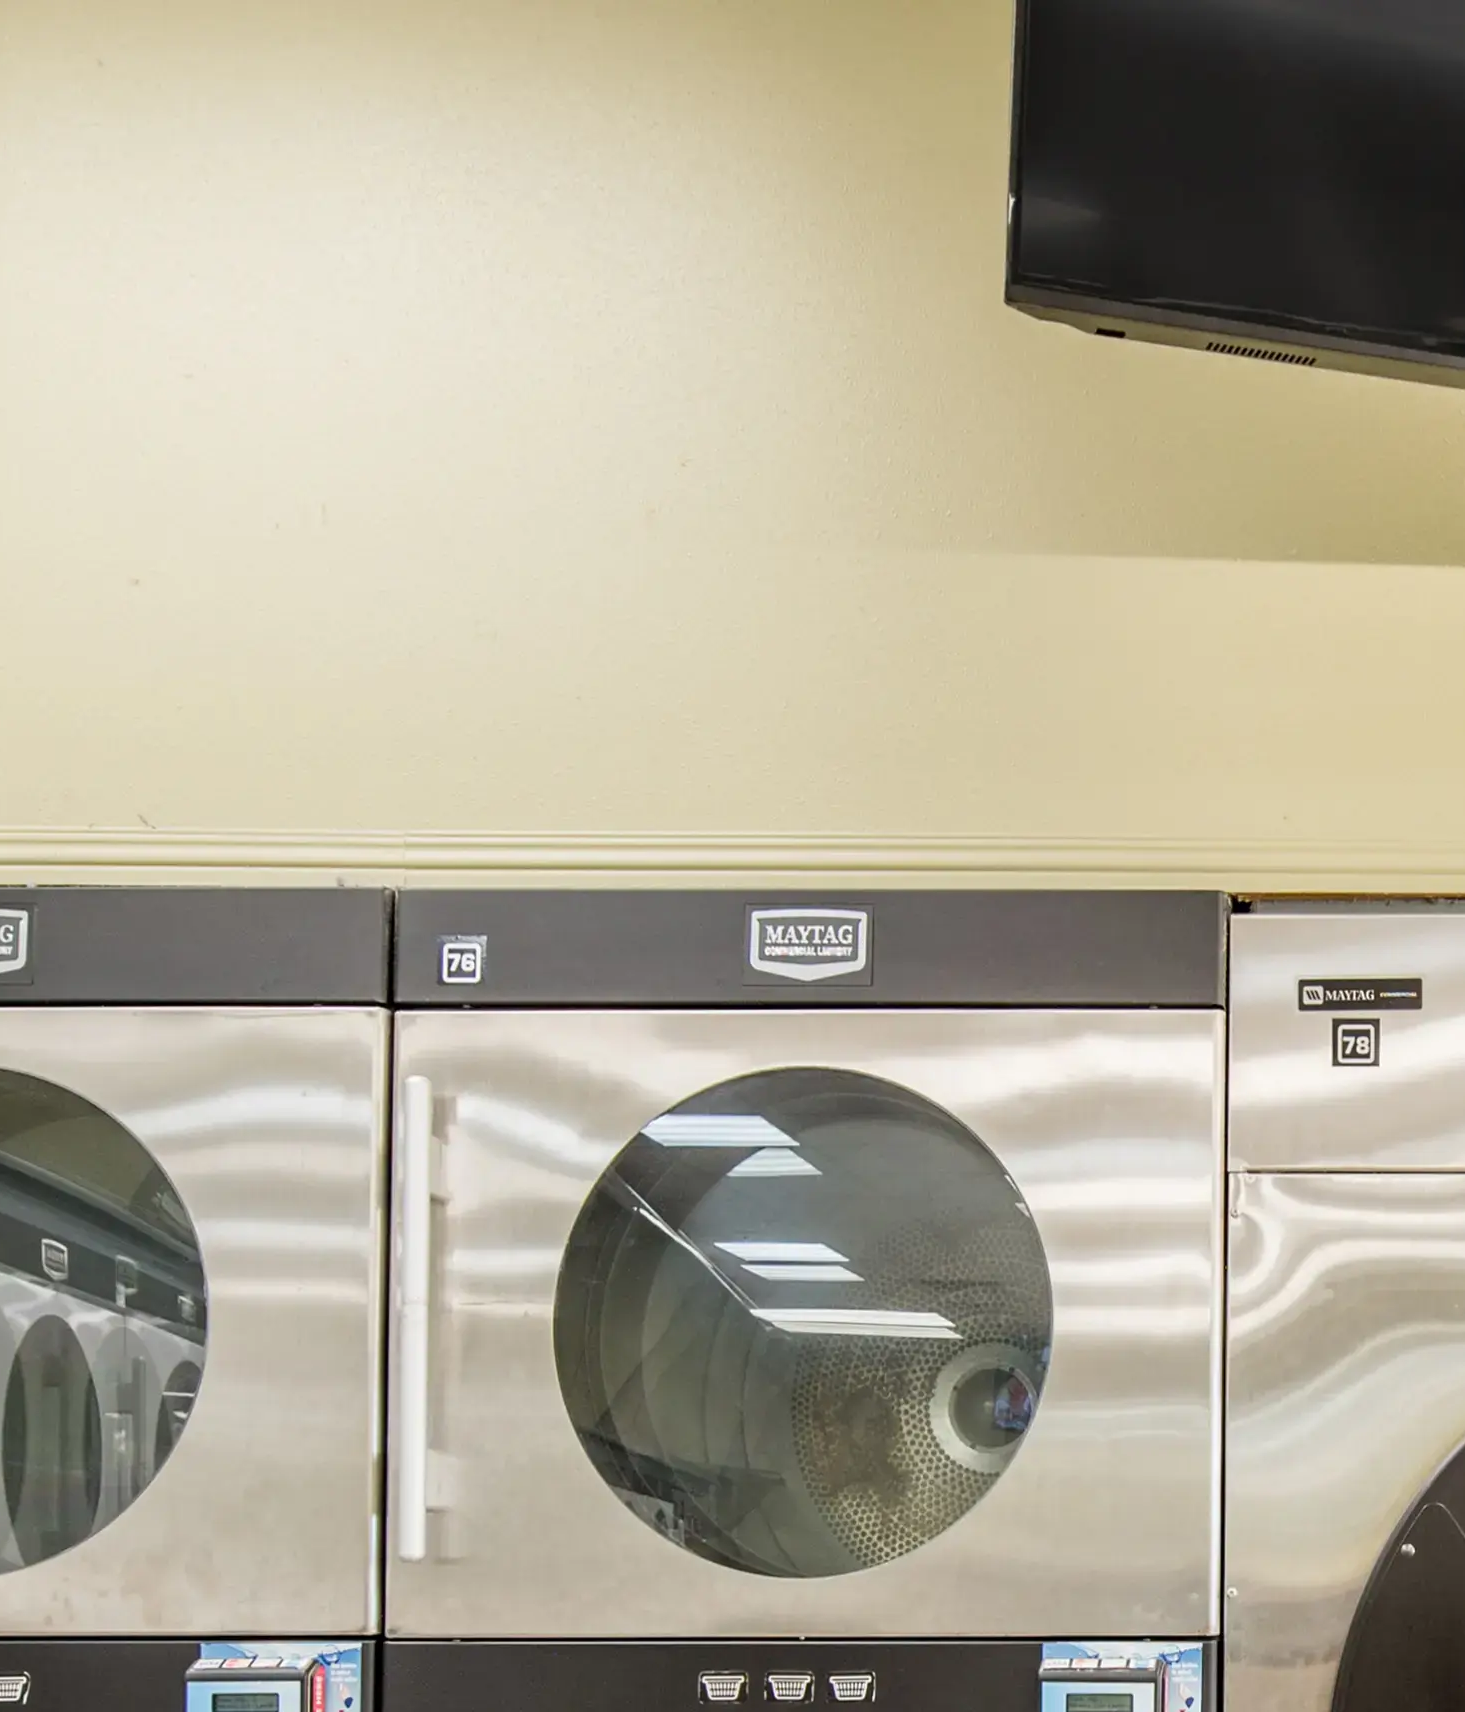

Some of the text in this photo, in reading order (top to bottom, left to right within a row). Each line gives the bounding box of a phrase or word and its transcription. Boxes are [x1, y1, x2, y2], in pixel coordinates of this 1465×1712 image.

[764, 925, 853, 945] MAYTAG
[448, 953, 475, 972] 76
[1325, 988, 1375, 1001] MAYTAG
[1343, 1036, 1370, 1055] 78
